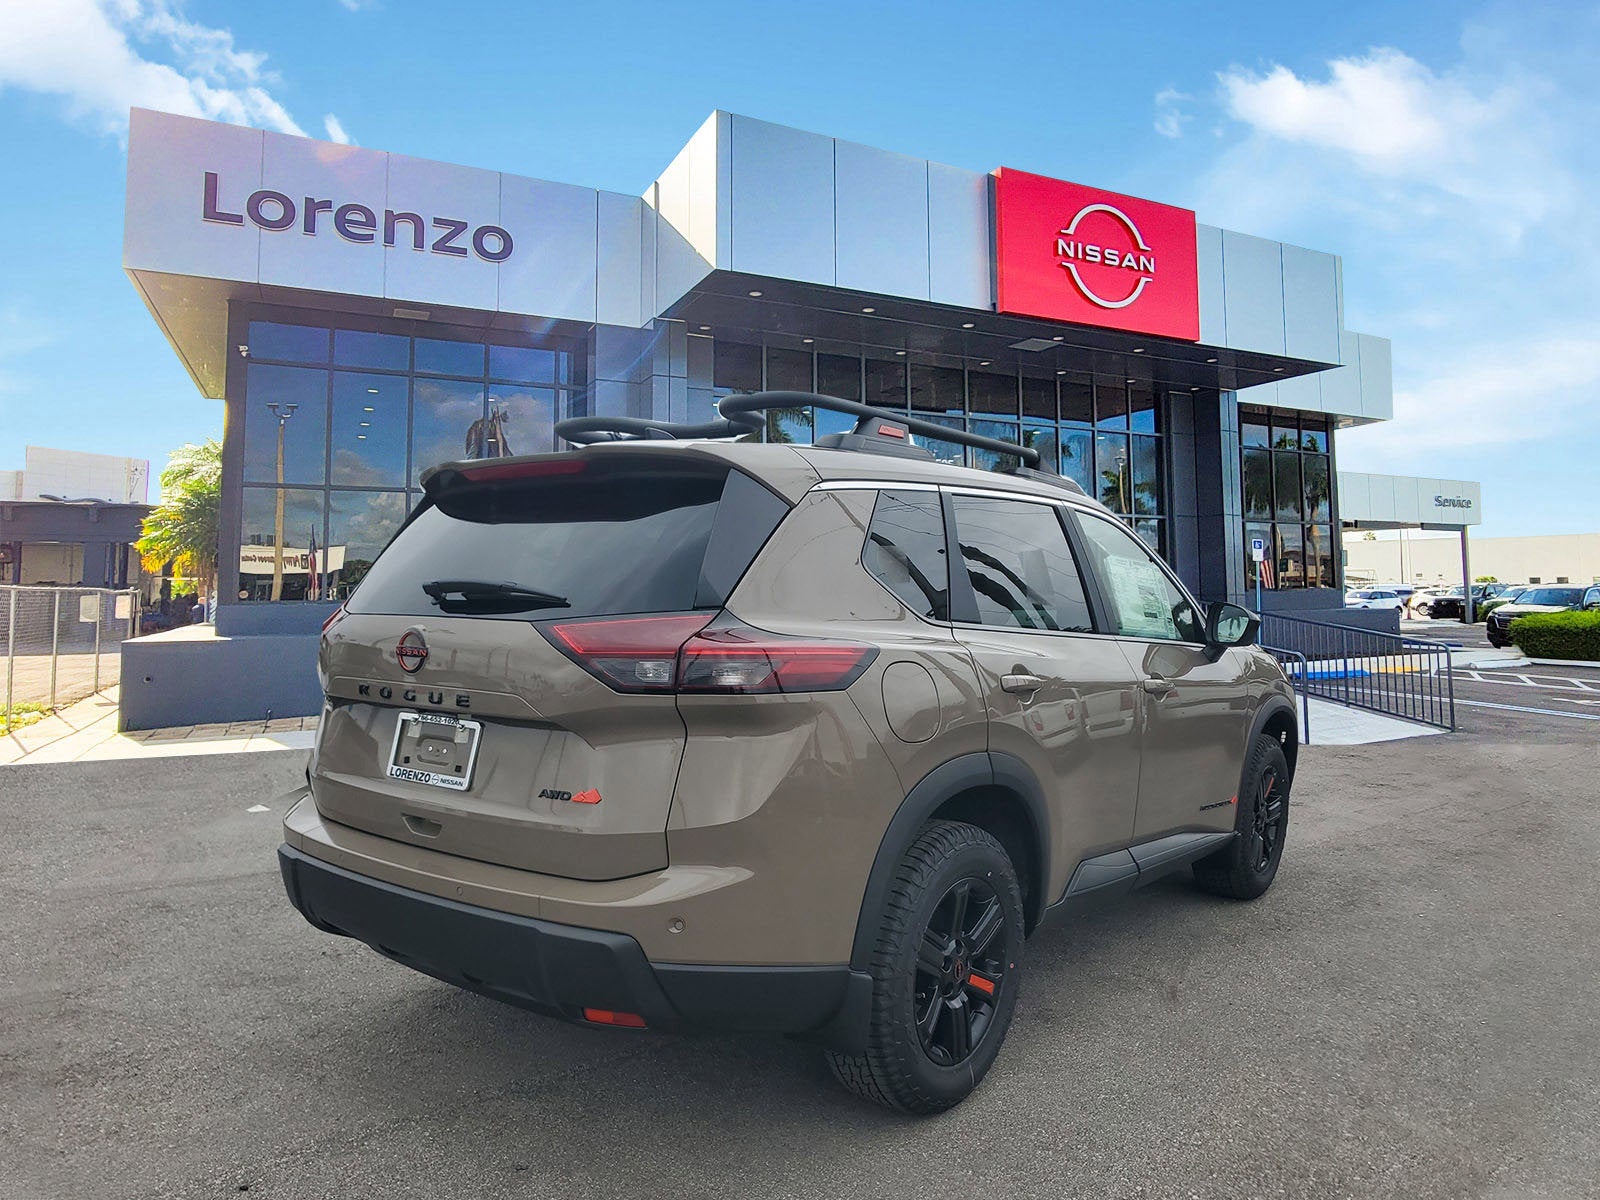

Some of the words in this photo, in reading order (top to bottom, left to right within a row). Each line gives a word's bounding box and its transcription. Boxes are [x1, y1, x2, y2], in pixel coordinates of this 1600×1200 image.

[202, 171, 514, 263] Lorenzo
[1057, 238, 1155, 273] NISSAN
[1434, 495, 1472, 509] Service
[358, 684, 471, 708] ROGUE
[389, 766, 431, 783] LORENZO
[440, 778, 464, 787] NISSAN
[538, 789, 572, 801] AWD
